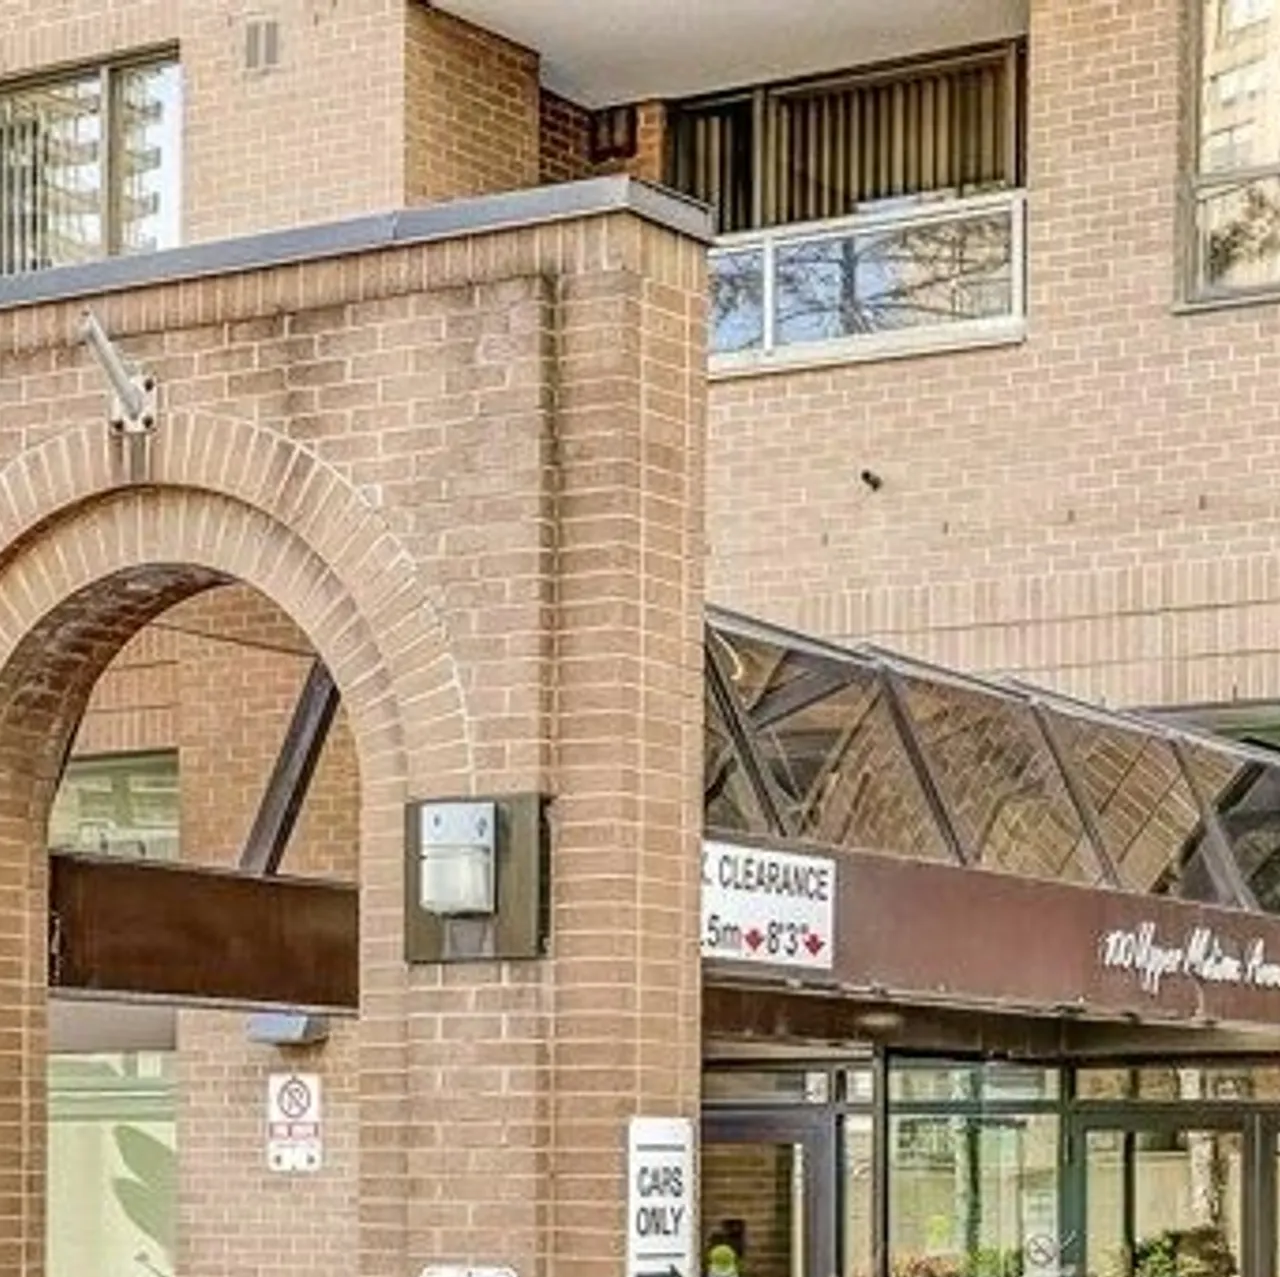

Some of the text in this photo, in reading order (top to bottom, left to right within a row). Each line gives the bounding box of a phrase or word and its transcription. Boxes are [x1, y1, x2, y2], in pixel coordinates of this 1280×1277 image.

[719, 854, 828, 901] CLEARANCE
[700, 914, 742, 950] .5m
[637, 1166, 683, 1197] CARS
[636, 1207, 685, 1237] ONLY
